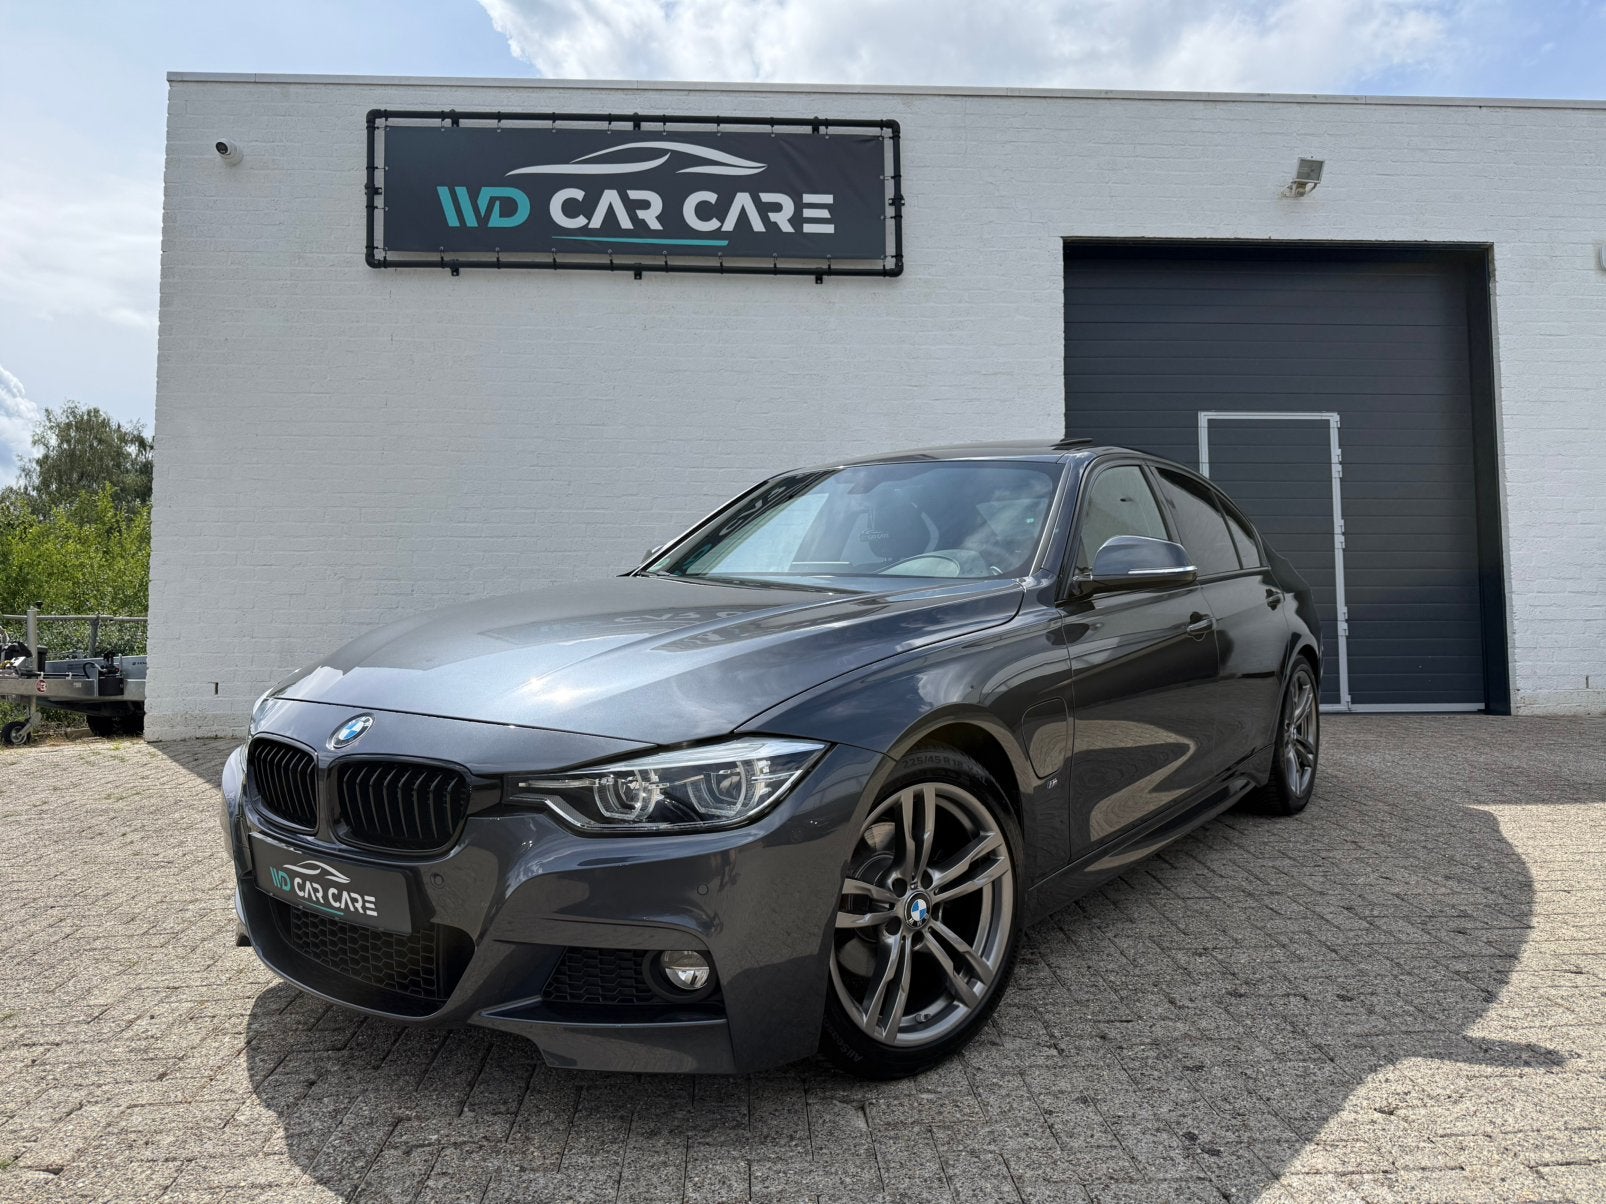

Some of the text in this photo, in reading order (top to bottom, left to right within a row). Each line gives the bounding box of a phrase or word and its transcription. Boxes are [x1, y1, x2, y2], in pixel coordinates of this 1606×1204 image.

[436, 185, 836, 234] WD CAR CARE
[269, 866, 378, 917] WD CAR CARE
